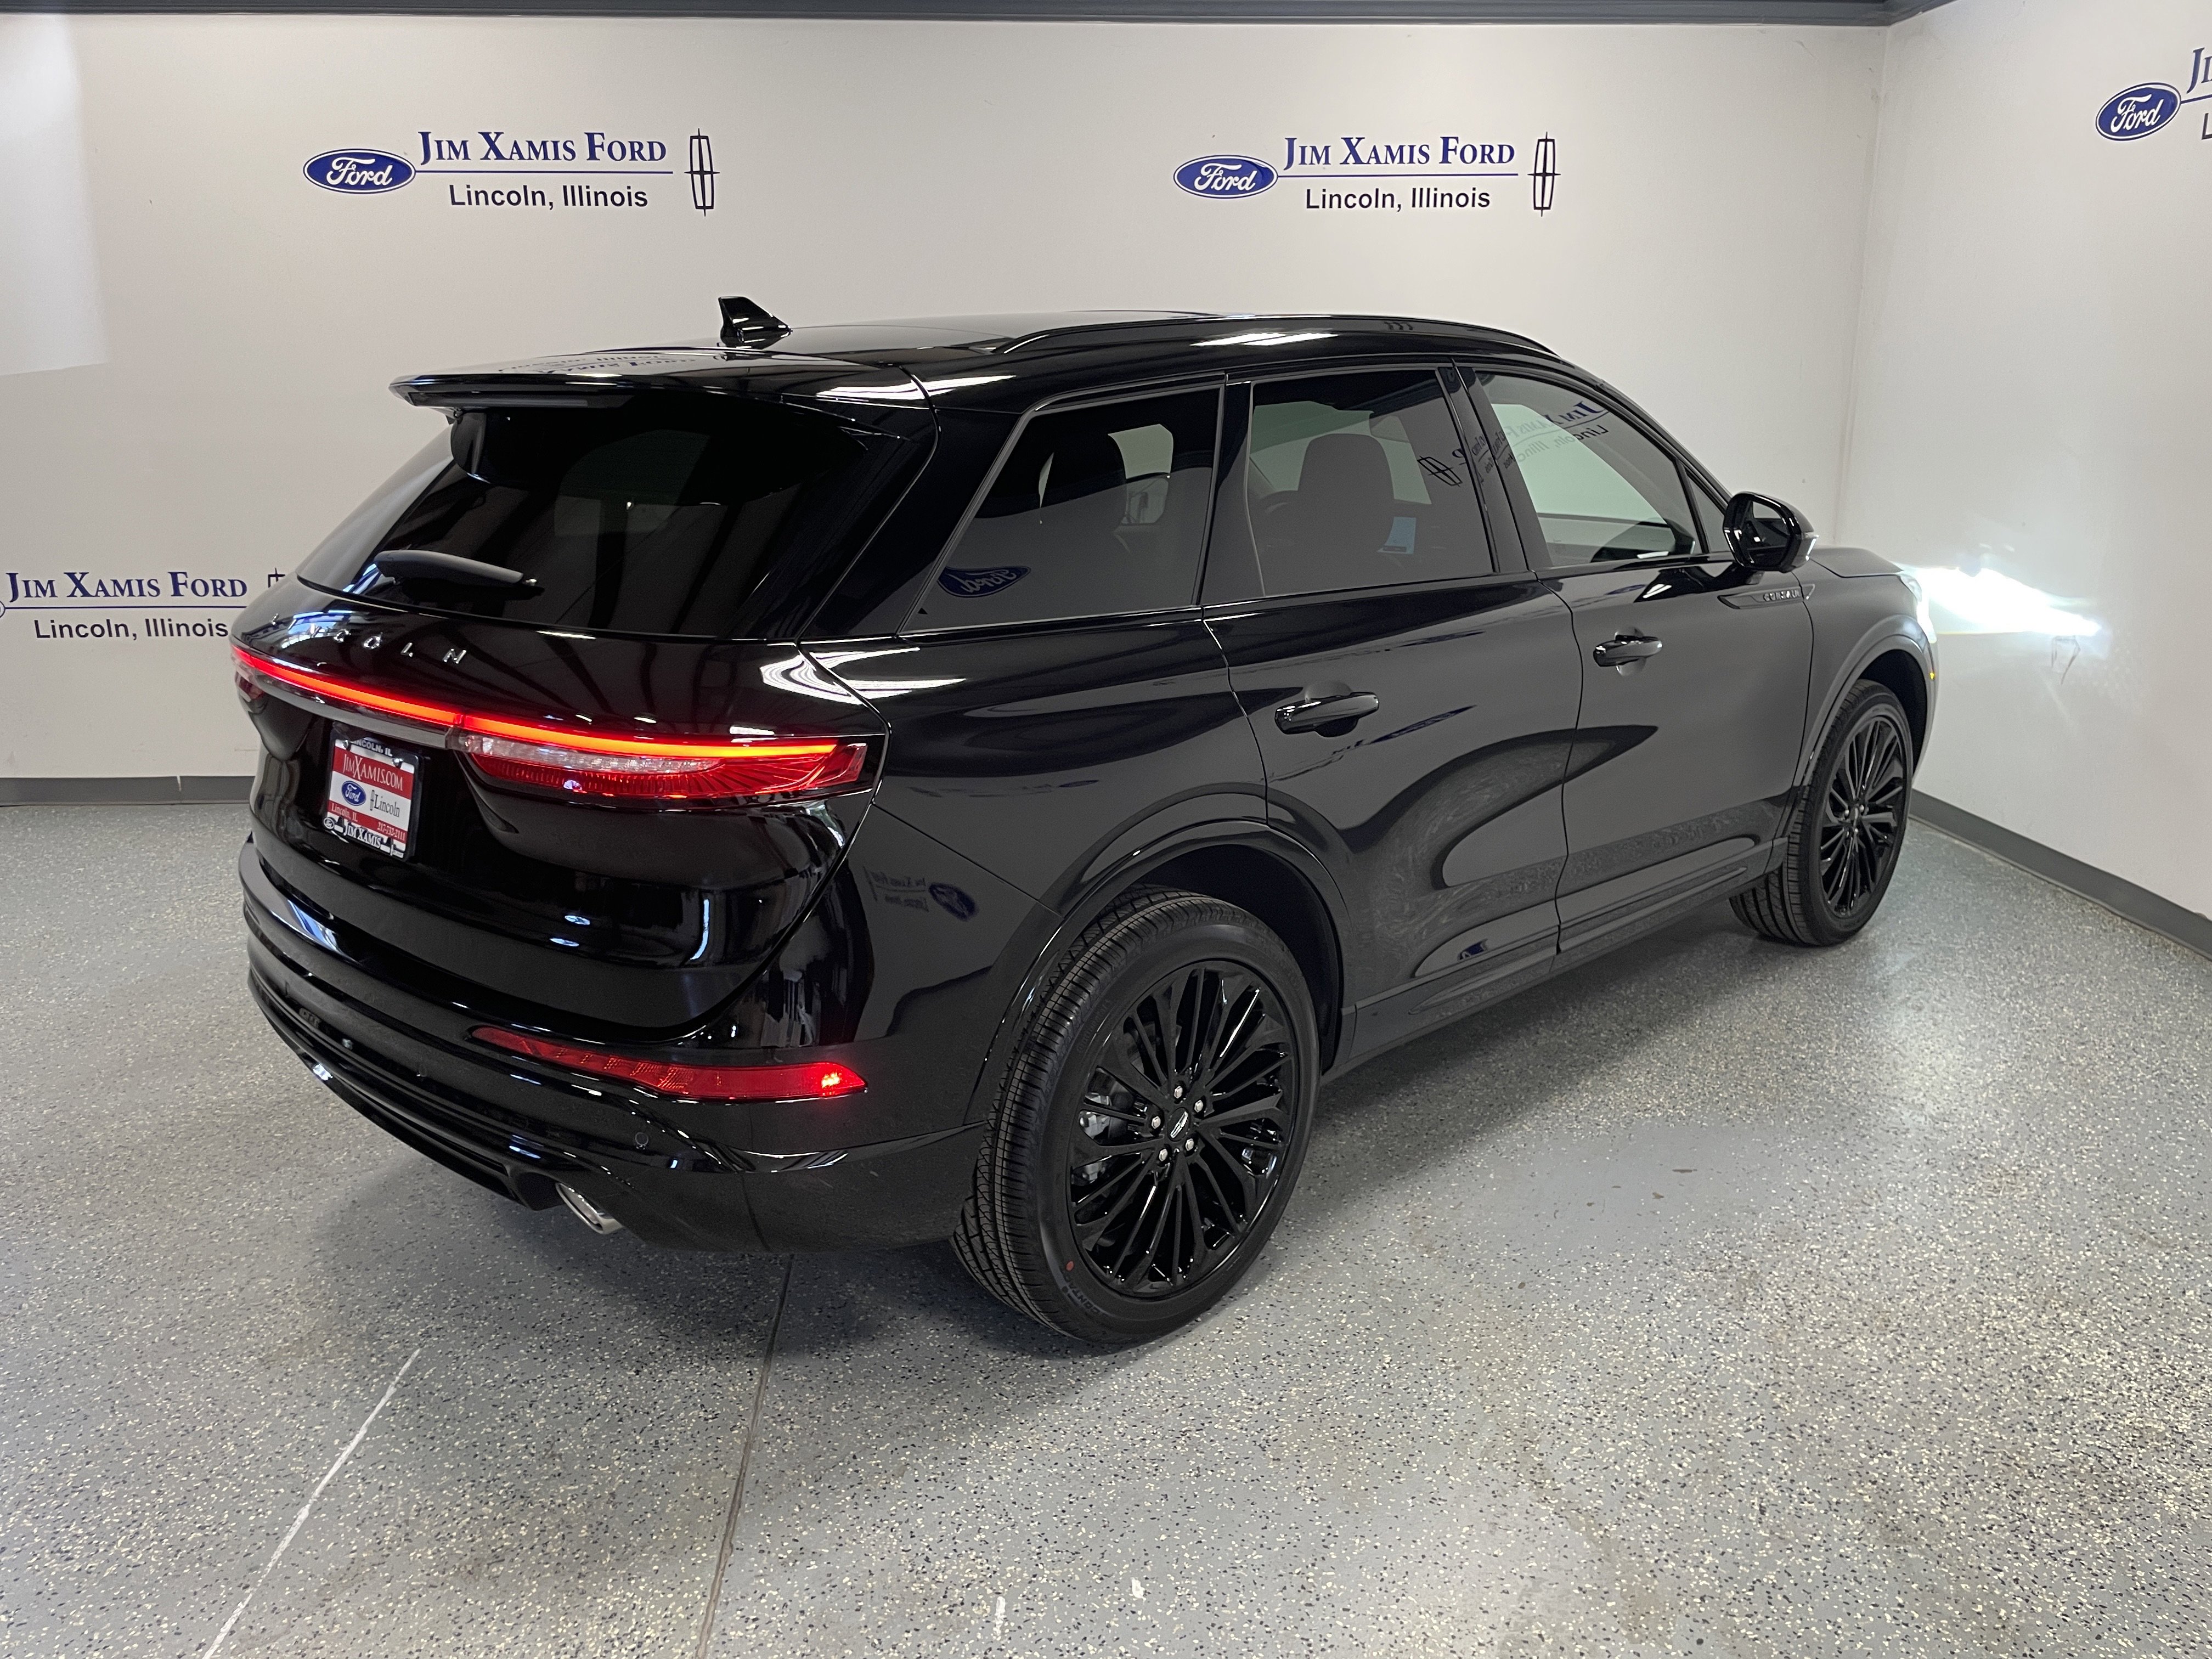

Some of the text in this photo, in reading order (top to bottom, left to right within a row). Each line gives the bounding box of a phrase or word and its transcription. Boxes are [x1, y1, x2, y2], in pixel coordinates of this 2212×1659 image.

[2186, 47, 2212, 94] JI
[2111, 94, 2164, 133] Ford
[417, 131, 667, 166] JIM XAMIS FORD
[1283, 136, 1515, 171] JIM XAMIS FORD
[326, 157, 393, 185] Ford
[1194, 163, 1257, 191] Ford
[449, 184, 648, 211] Lincoln, Illinois
[1306, 187, 1490, 212] Lincoln, Illinois
[5, 571, 247, 603] JIM XAMIS FORD
[35, 618, 228, 641] Lincoln, Illinois
[352, 739, 393, 757] NCOLN, IL
[342, 754, 403, 791] JIMXAMIS.COM
[374, 794, 400, 818] Lincoln
[343, 823, 357, 840] JIM
[358, 830, 382, 849] XAMIS
